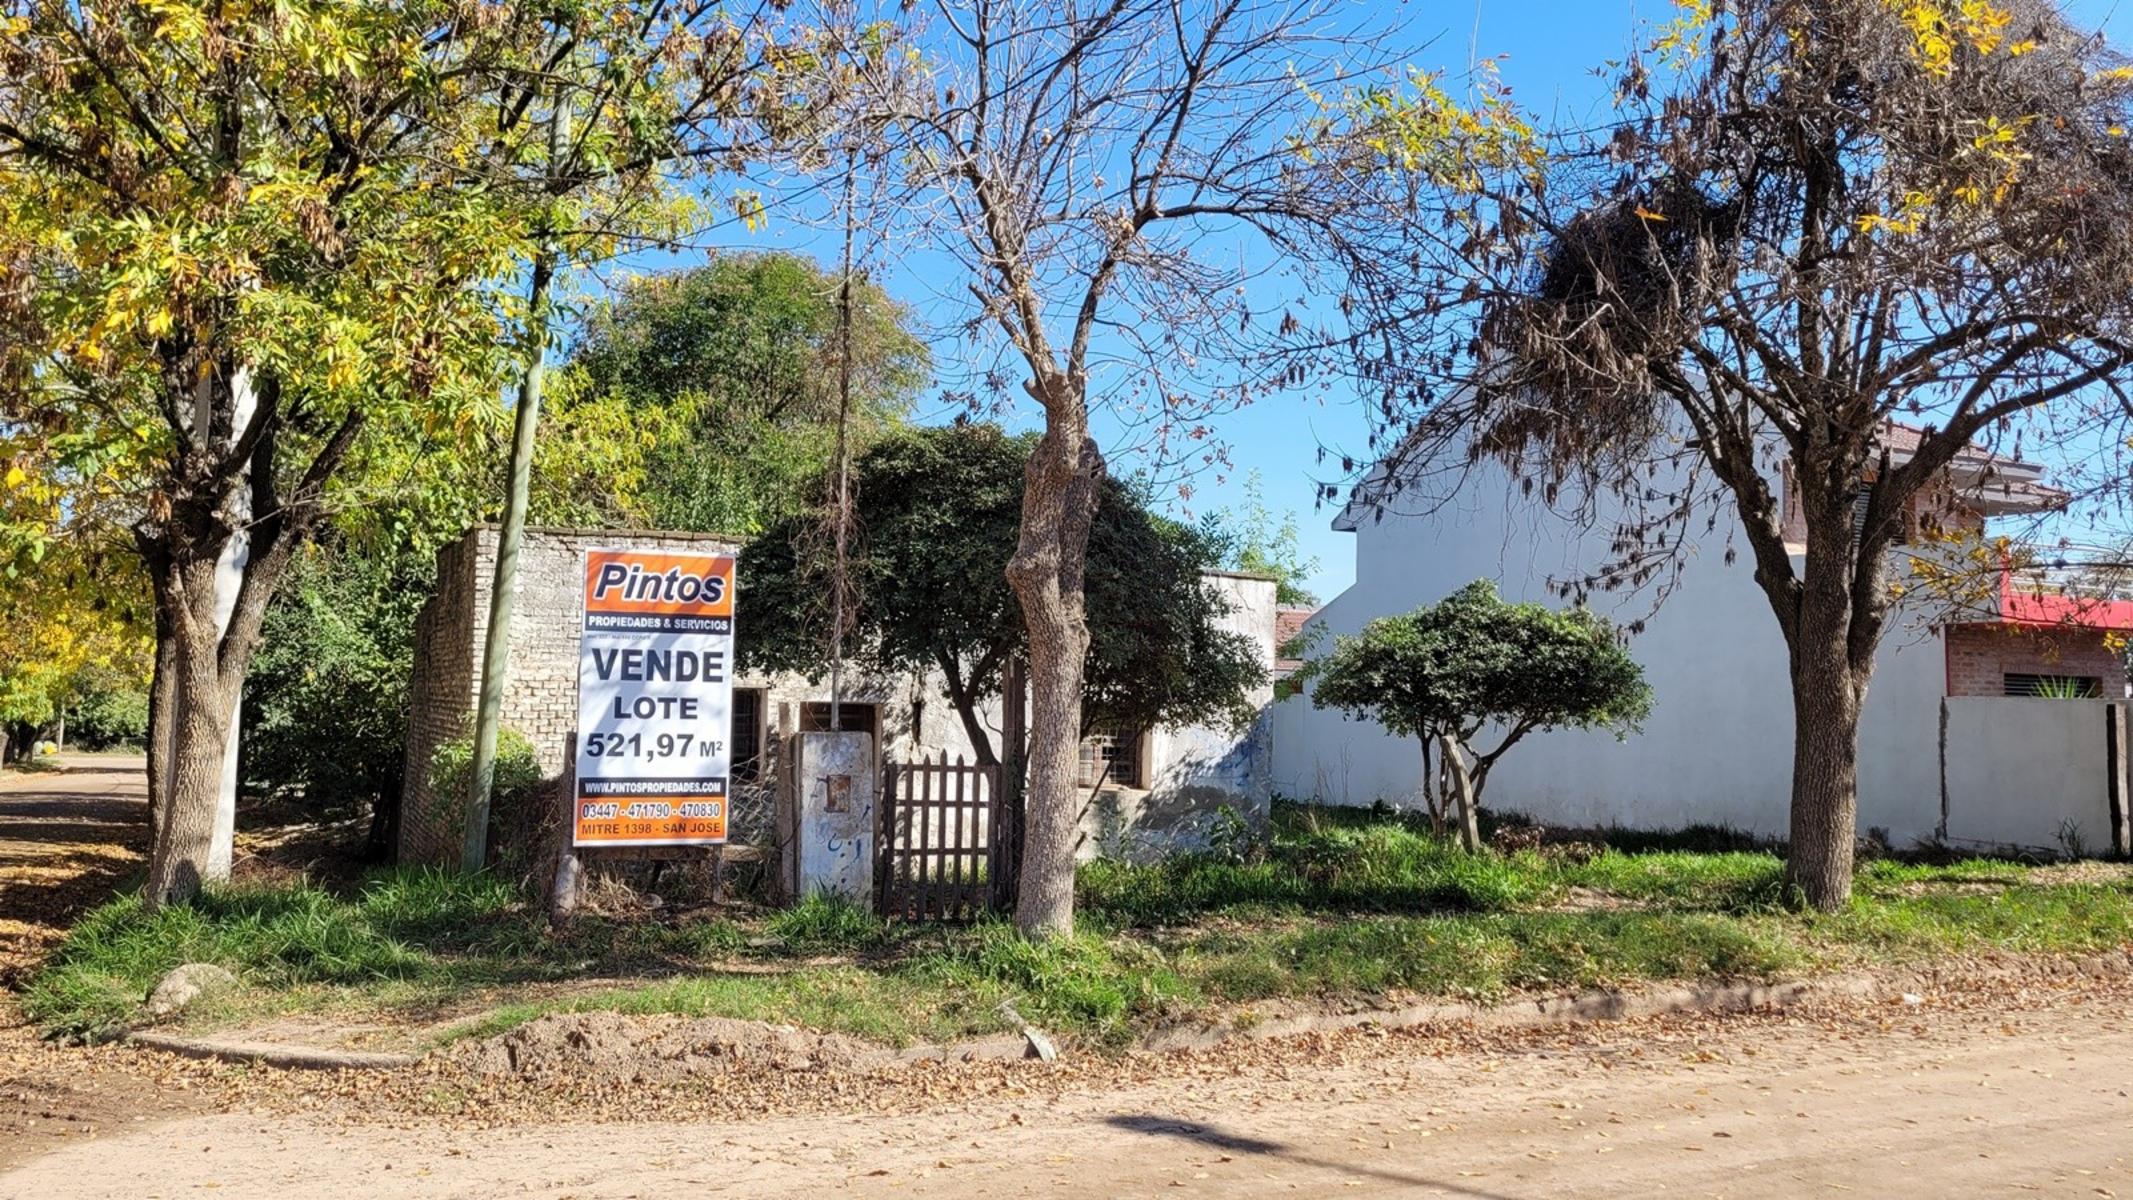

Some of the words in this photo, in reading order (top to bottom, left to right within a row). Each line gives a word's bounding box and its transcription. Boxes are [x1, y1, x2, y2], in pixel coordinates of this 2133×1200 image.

[595, 564, 724, 602] Pintos
[588, 615, 661, 629] PROPIEDADES
[663, 618, 671, 629] &
[674, 618, 729, 631] SERVICIOS
[591, 648, 724, 683] VENDE
[614, 696, 699, 720] LOTE
[586, 732, 694, 763] 521,97
[585, 781, 721, 793] WWW.PINTOSPROPIEDADES.COM
[582, 803, 618, 818] 03447
[628, 803, 670, 818] 471790
[679, 802, 721, 818] 470830
[582, 823, 621, 835] MITRE
[624, 823, 652, 834] 1398
[662, 823, 686, 833] SAN
[690, 822, 721, 833] JOSE
